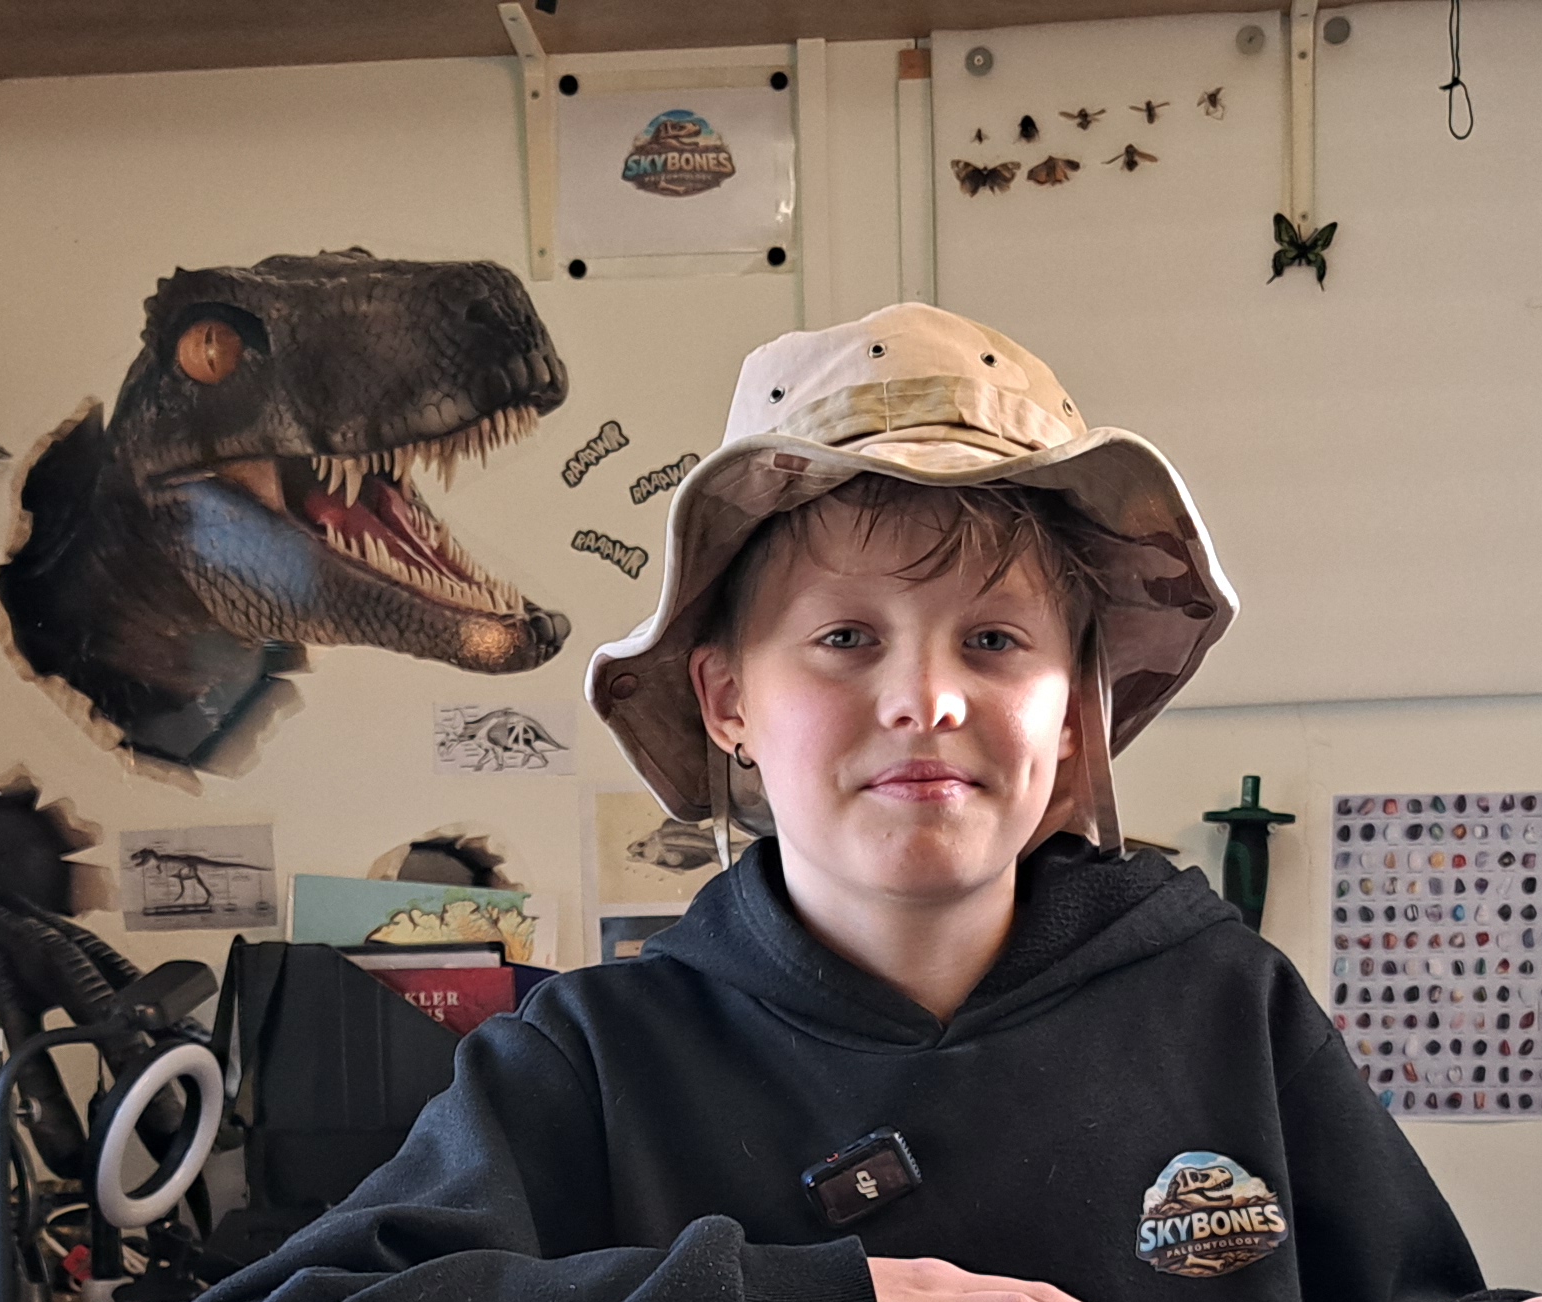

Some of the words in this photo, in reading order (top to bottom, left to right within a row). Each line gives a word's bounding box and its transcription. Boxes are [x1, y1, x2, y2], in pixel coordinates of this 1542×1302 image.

[623, 151, 734, 179] SKYBONES
[1140, 1205, 1285, 1252] SKYBONES
[1166, 1237, 1259, 1258] PALEONTOLOGY
